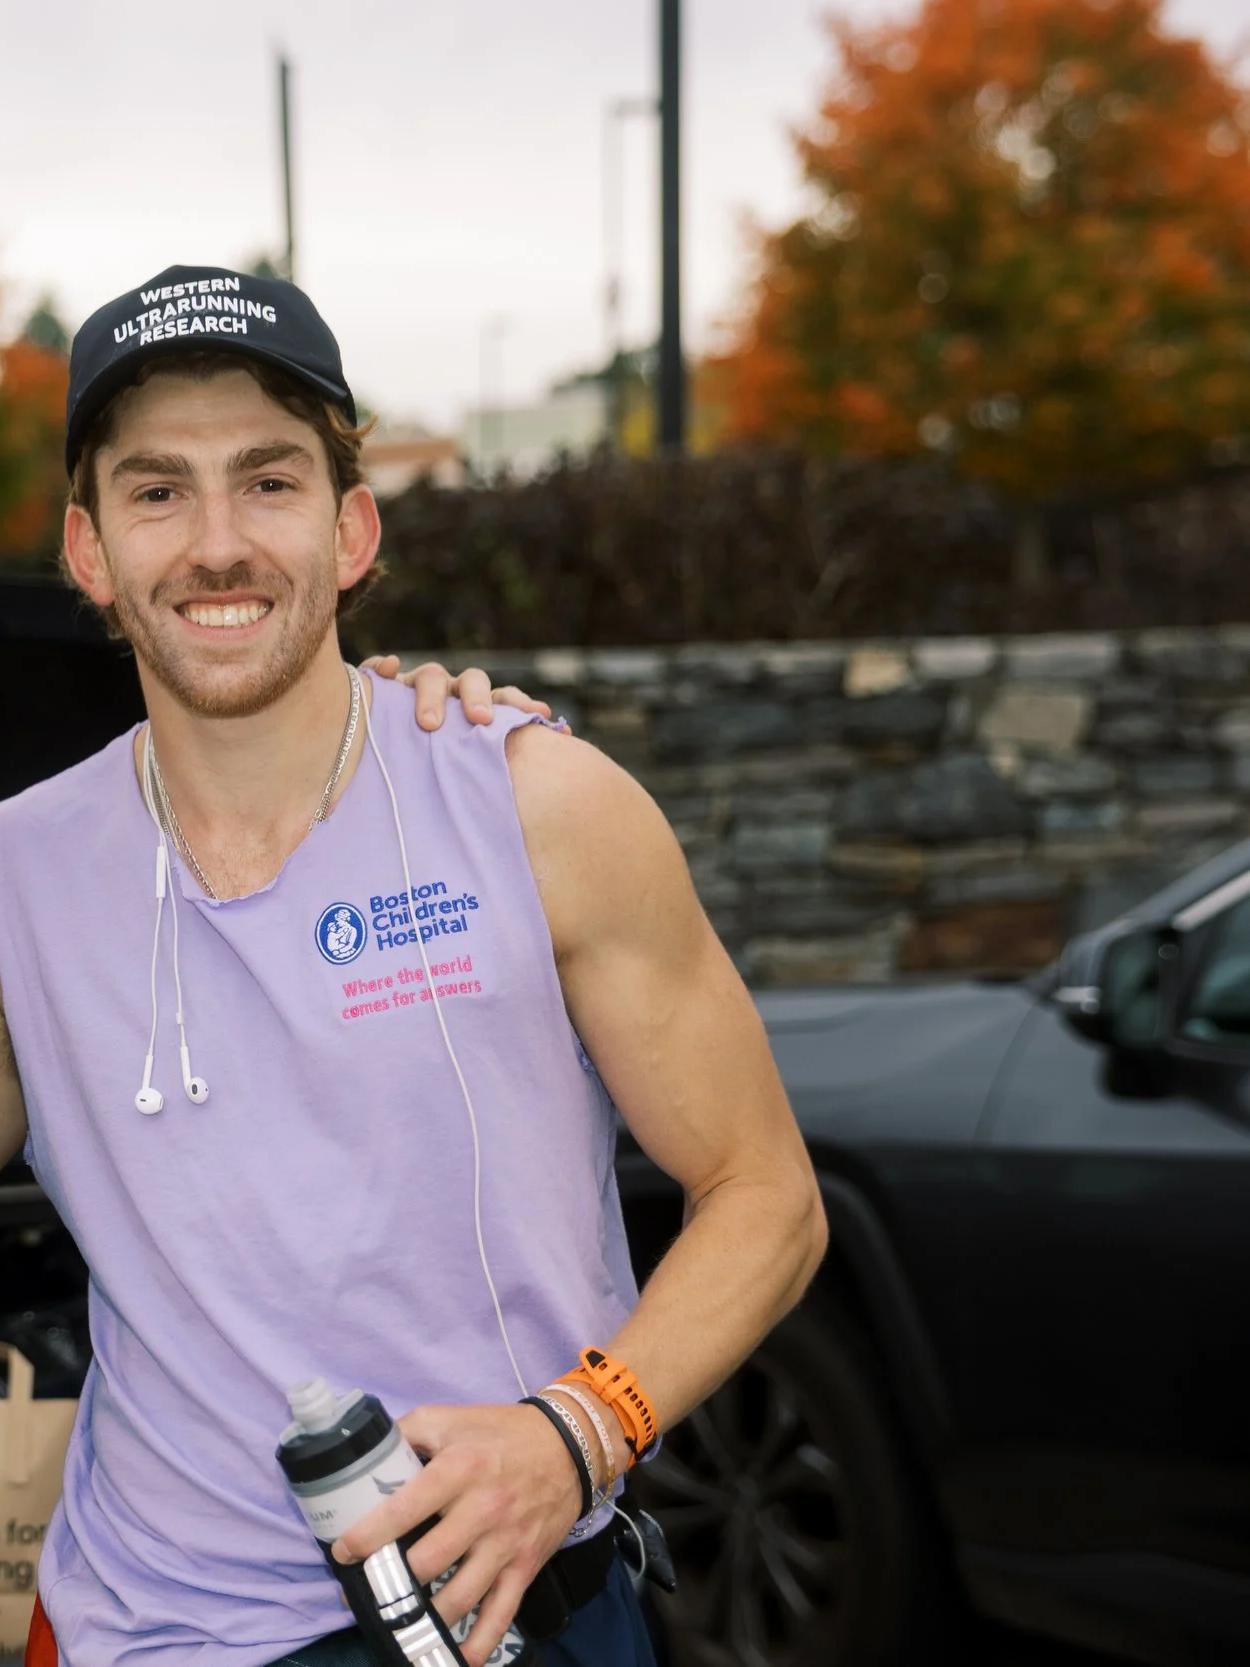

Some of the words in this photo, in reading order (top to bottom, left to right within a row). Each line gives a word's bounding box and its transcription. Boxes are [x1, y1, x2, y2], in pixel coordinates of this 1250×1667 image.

[140, 277, 240, 305] WESTERN
[113, 295, 277, 343] ULTRARUNNING
[139, 316, 248, 346] RESEARCH
[369, 881, 447, 913] Boston
[376, 914, 468, 951] Hospital
[342, 975, 394, 998] Where
[396, 966, 424, 985] the
[428, 954, 473, 977] world
[342, 999, 390, 1020] comes
[391, 989, 416, 1007] for
